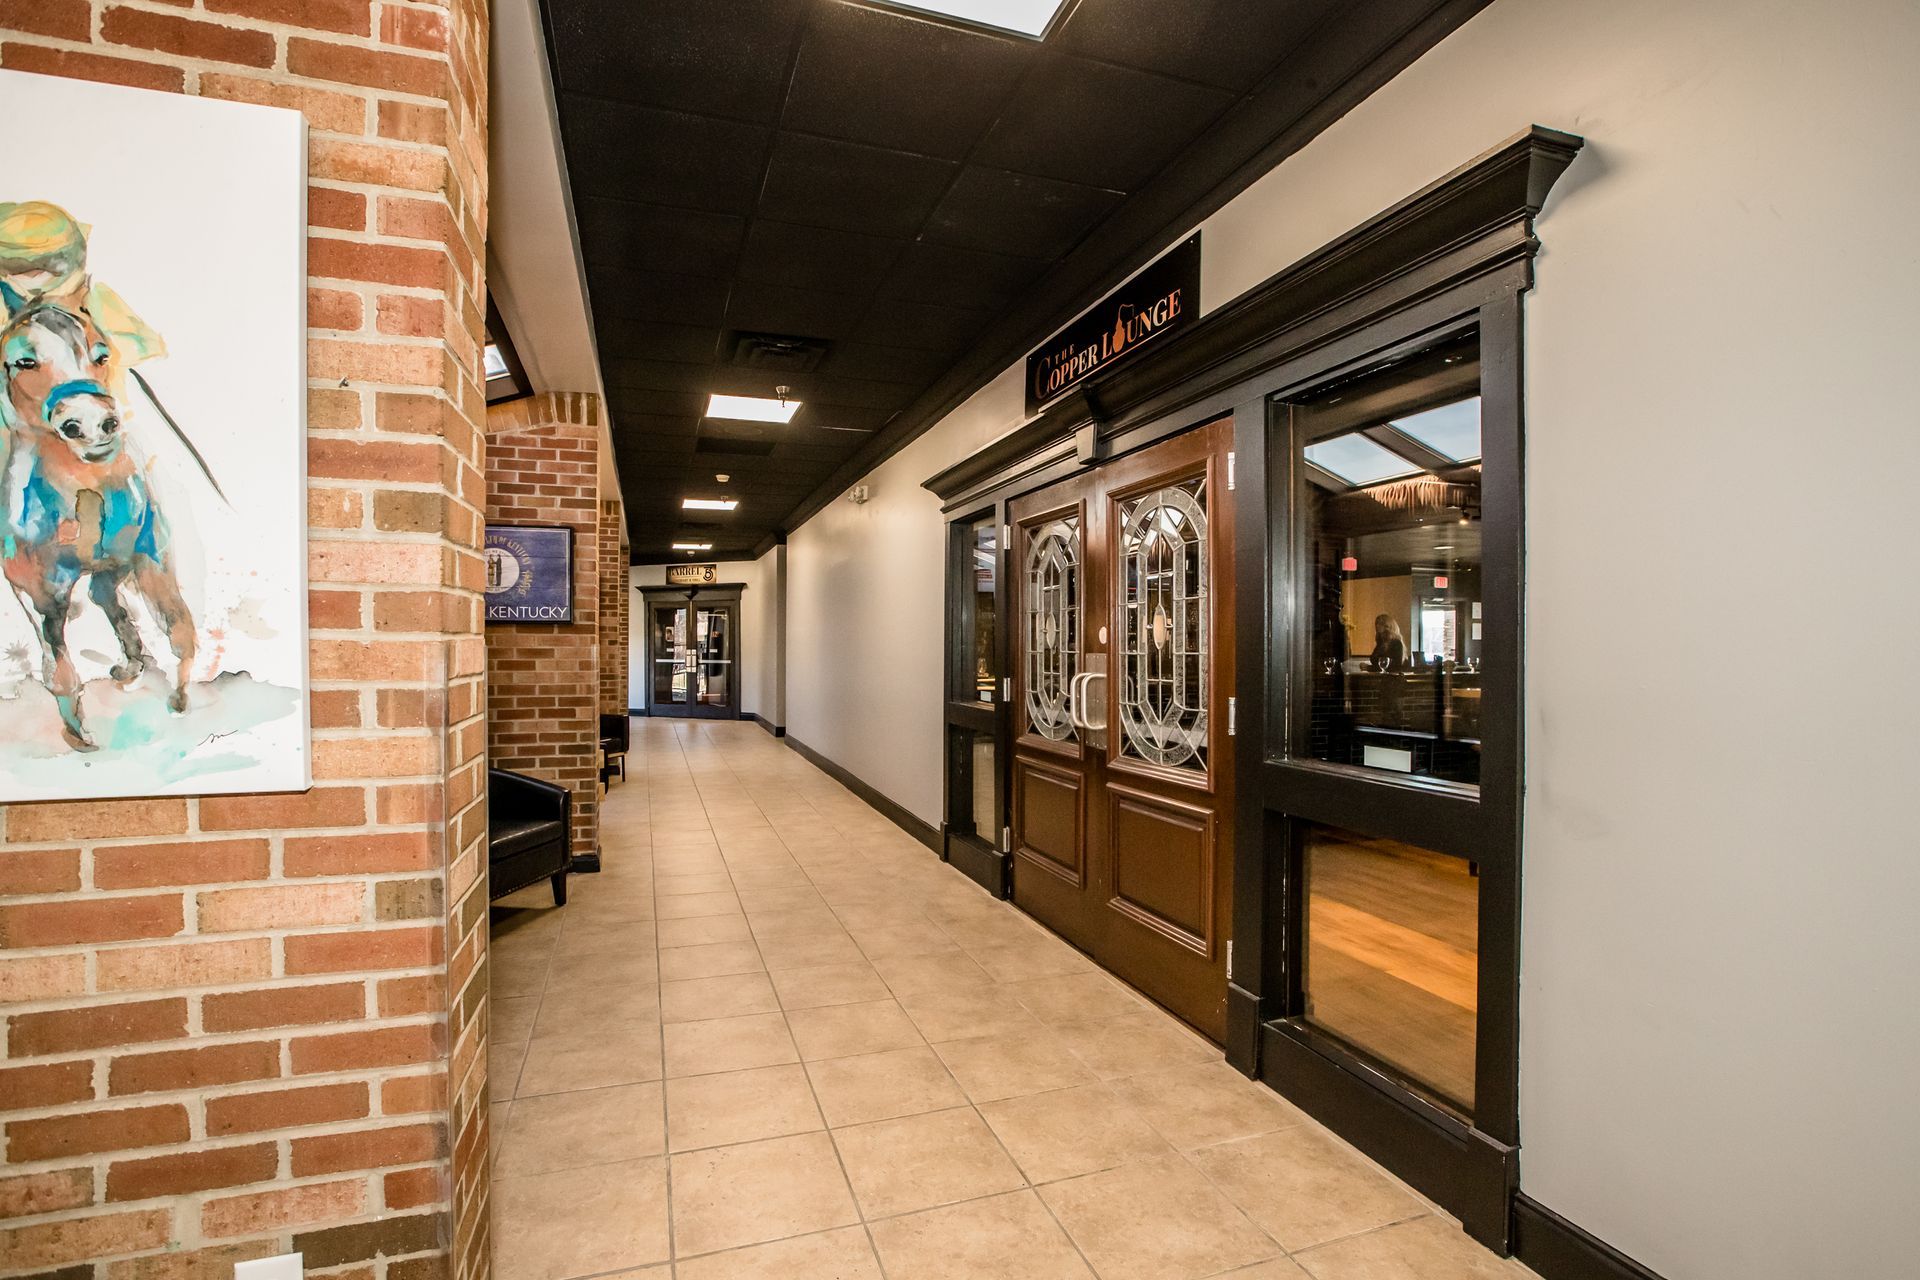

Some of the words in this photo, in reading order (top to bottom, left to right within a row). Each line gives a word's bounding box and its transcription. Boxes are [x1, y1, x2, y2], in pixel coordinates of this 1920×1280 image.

[1054, 343, 1075, 365] THE
[1035, 343, 1098, 399] COPPER
[489, 606, 568, 619] KENTUCKY
